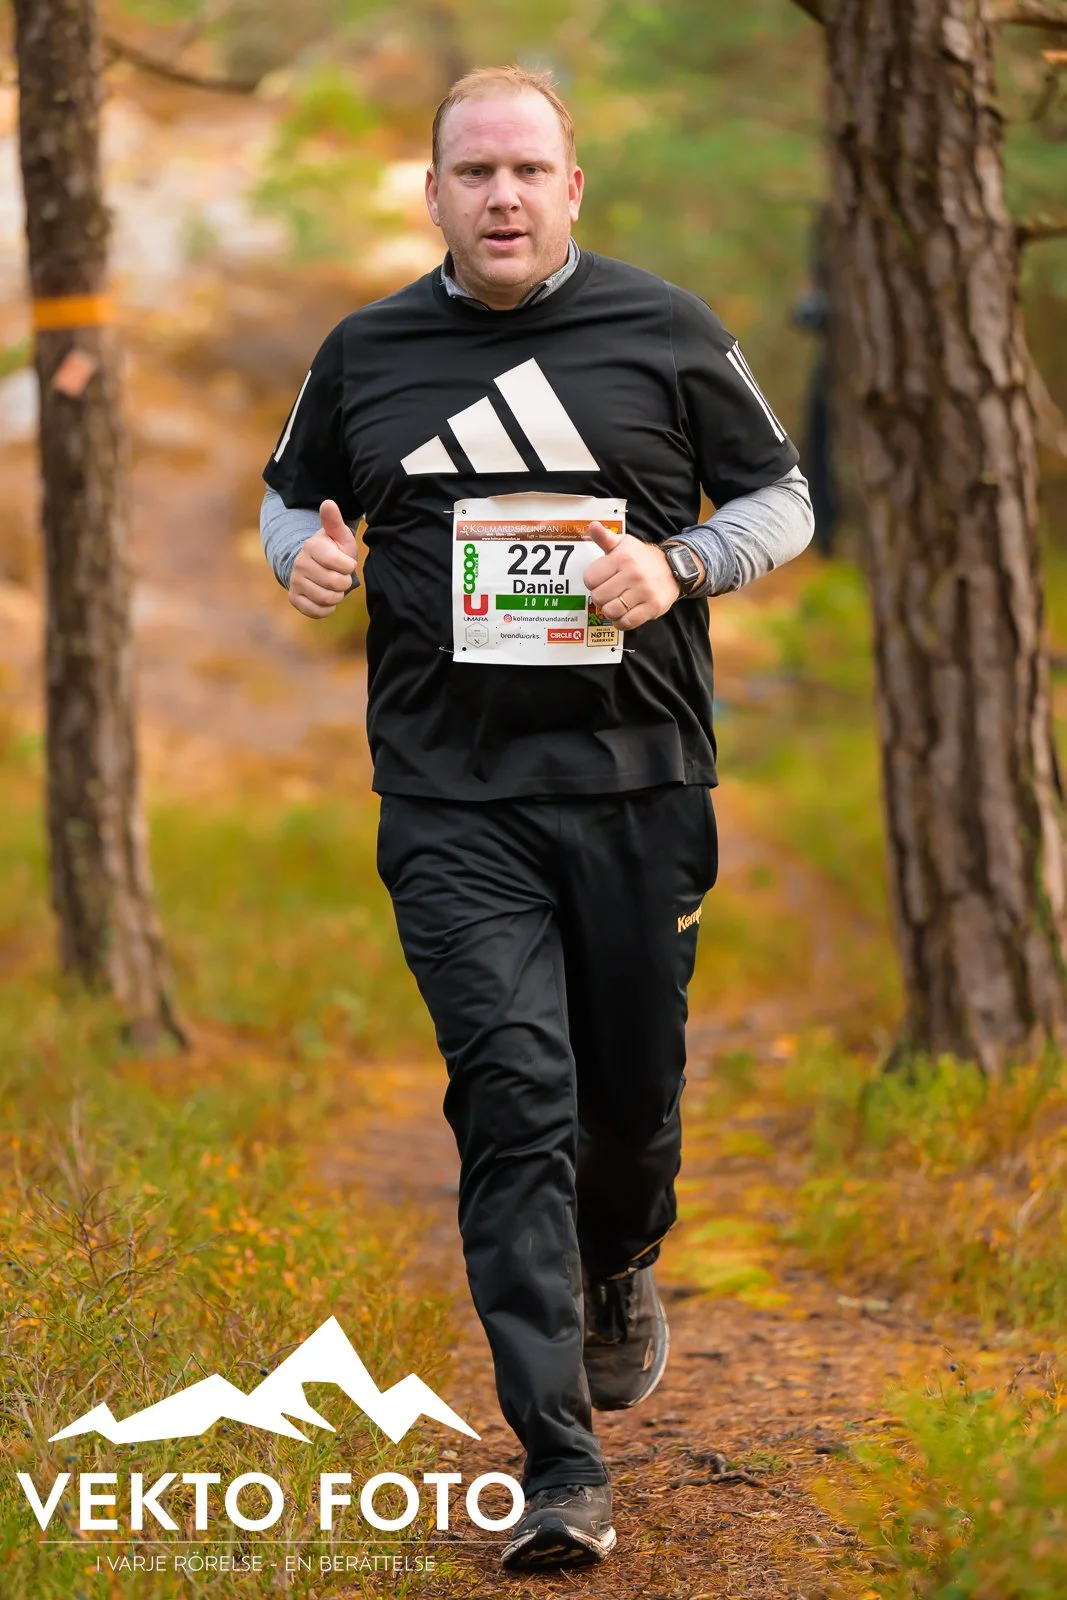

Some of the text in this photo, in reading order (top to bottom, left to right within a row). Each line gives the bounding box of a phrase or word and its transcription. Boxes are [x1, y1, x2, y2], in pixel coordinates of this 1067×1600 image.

[464, 544, 478, 594] coop
[508, 544, 574, 576] 227
[513, 580, 570, 594] Daniel
[524, 598, 558, 606] 10 KM
